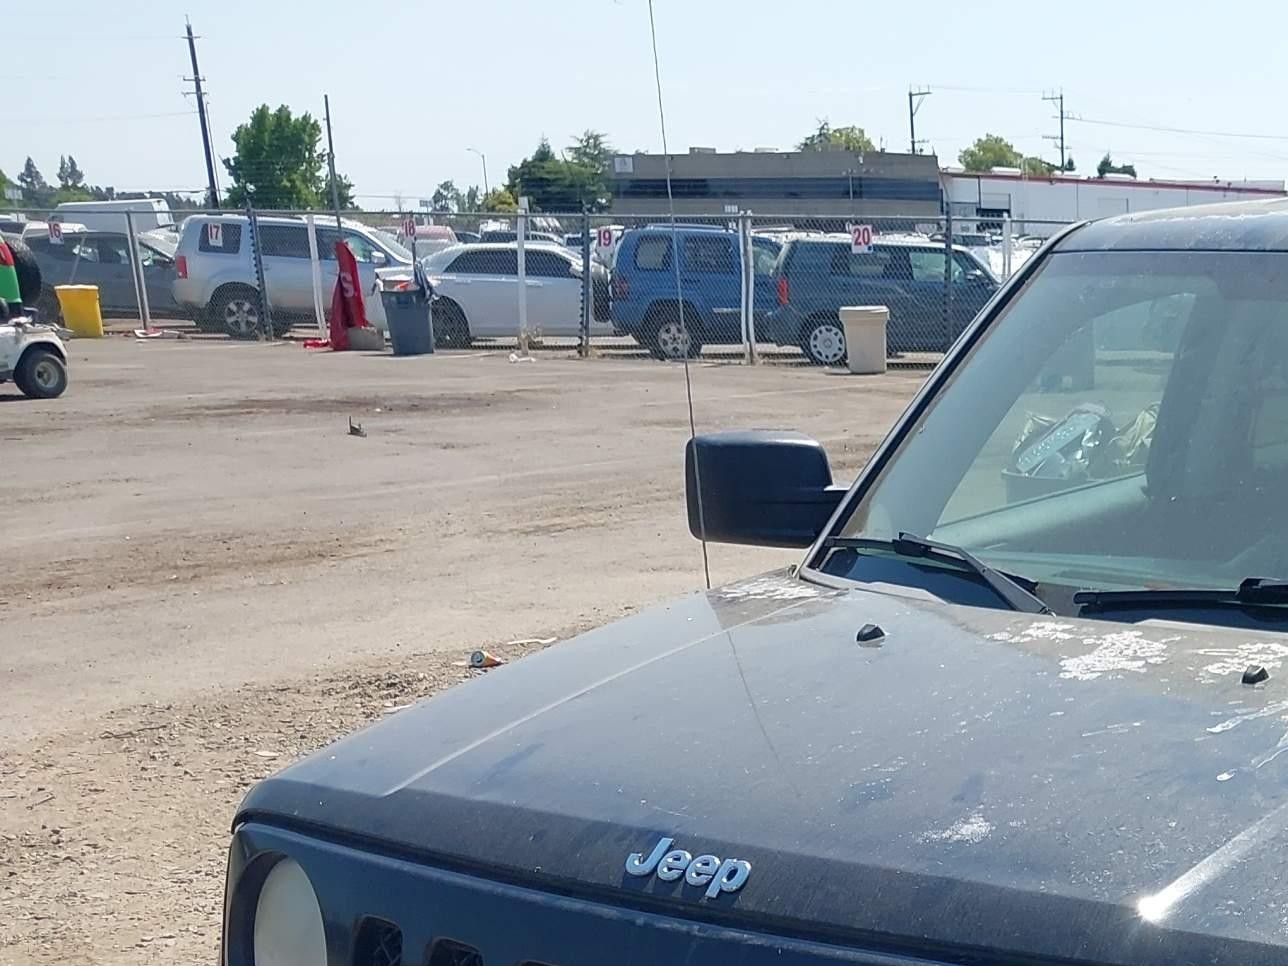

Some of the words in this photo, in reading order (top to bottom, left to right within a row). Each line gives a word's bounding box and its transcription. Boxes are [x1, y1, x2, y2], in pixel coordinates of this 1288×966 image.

[48, 223, 61, 239] 16
[208, 223, 222, 241] 17
[402, 220, 416, 237] 18
[597, 228, 612, 247] 19
[853, 227, 871, 246] 20
[625, 837, 752, 898] Jeep
